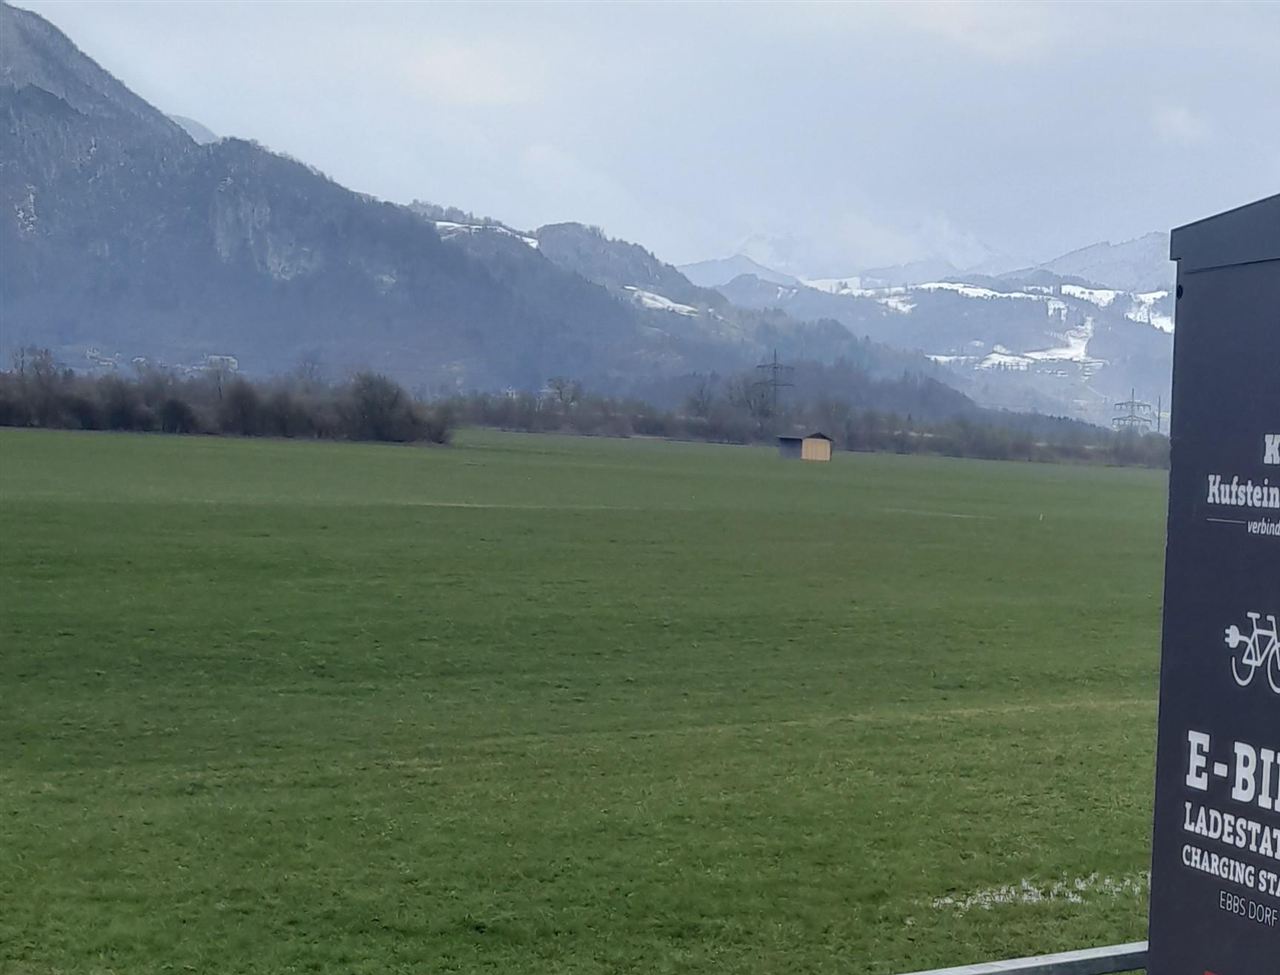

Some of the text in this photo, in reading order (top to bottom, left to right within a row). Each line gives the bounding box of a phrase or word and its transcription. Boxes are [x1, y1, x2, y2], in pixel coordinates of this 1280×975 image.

[1182, 844, 1255, 888] CHARGING
[1219, 890, 1279, 927] EBBS DORF
